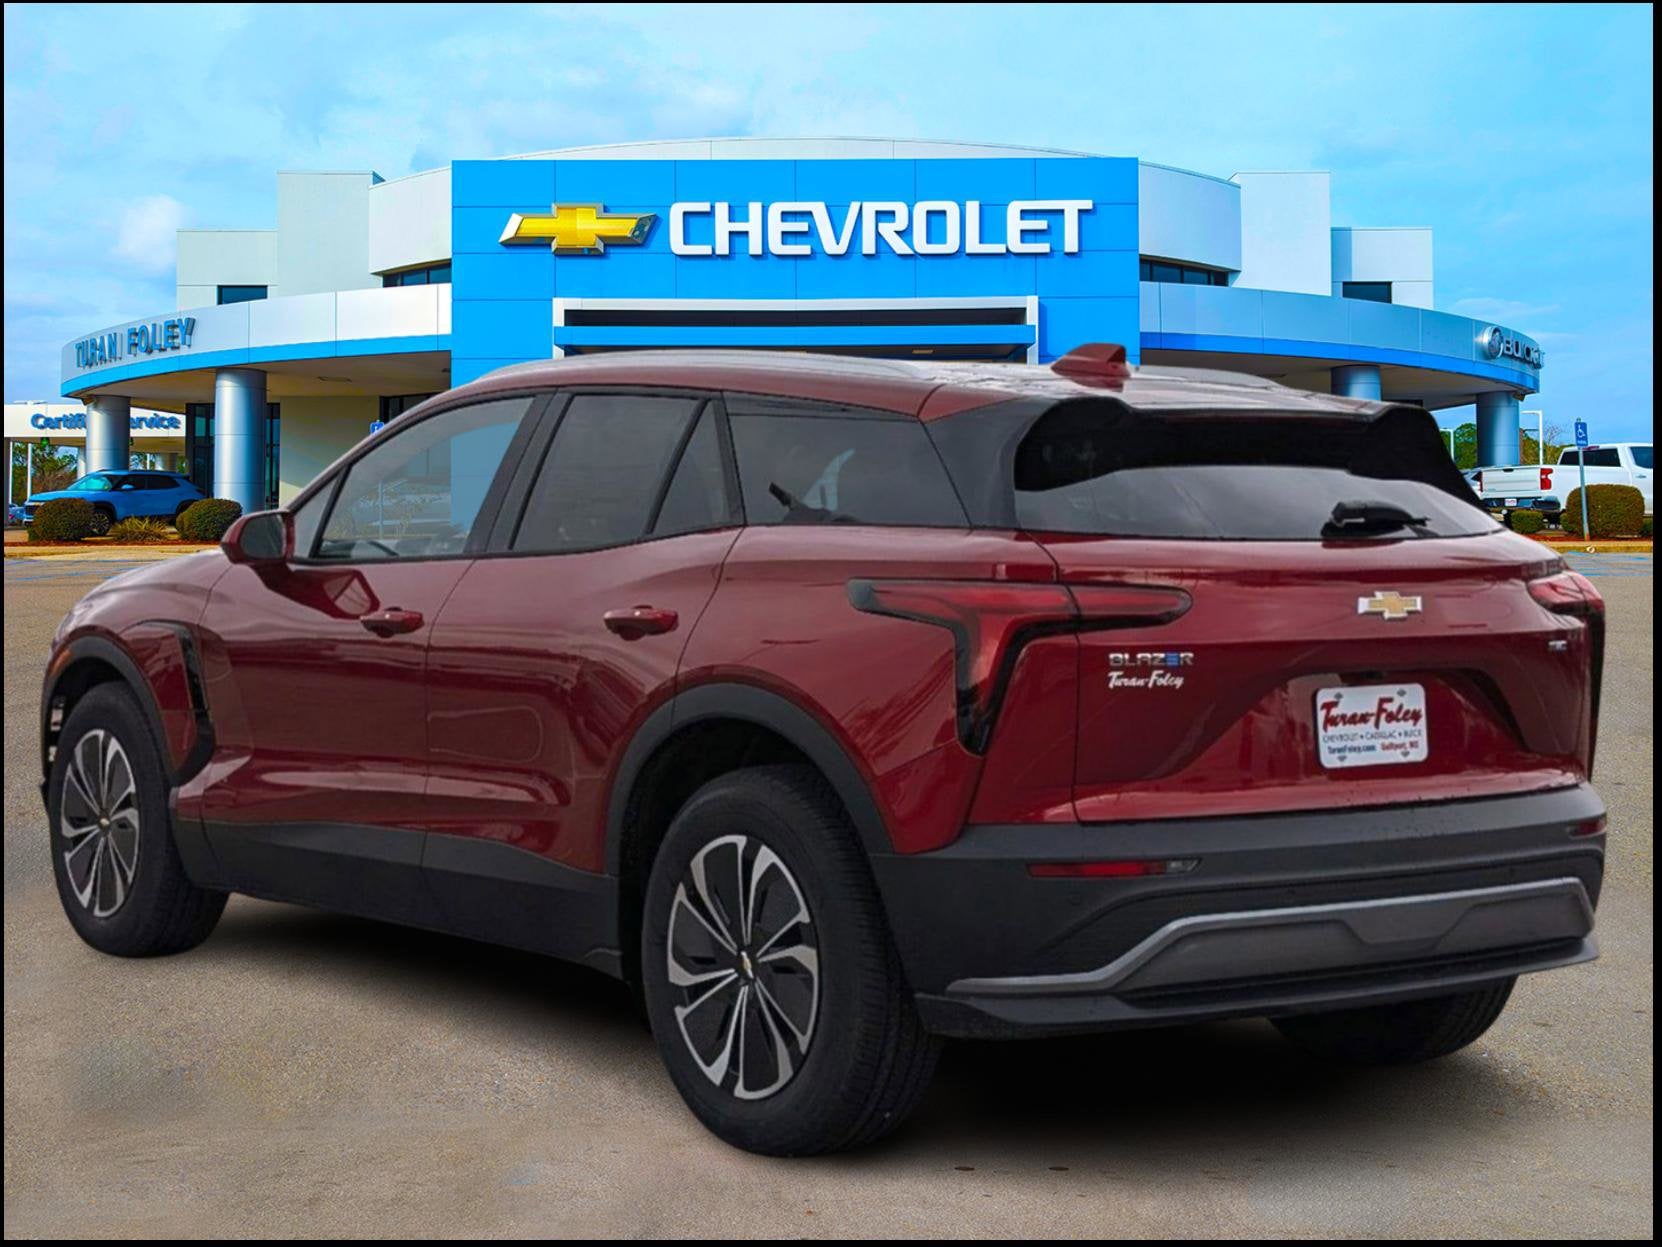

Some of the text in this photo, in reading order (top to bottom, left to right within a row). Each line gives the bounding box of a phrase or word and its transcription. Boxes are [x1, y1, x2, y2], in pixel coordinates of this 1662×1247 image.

[669, 199, 1094, 257] CHEVROLET
[75, 317, 196, 368] TURAN FOLEY
[31, 413, 181, 430] Certifi ervice
[1109, 652, 1194, 667] BLAZER
